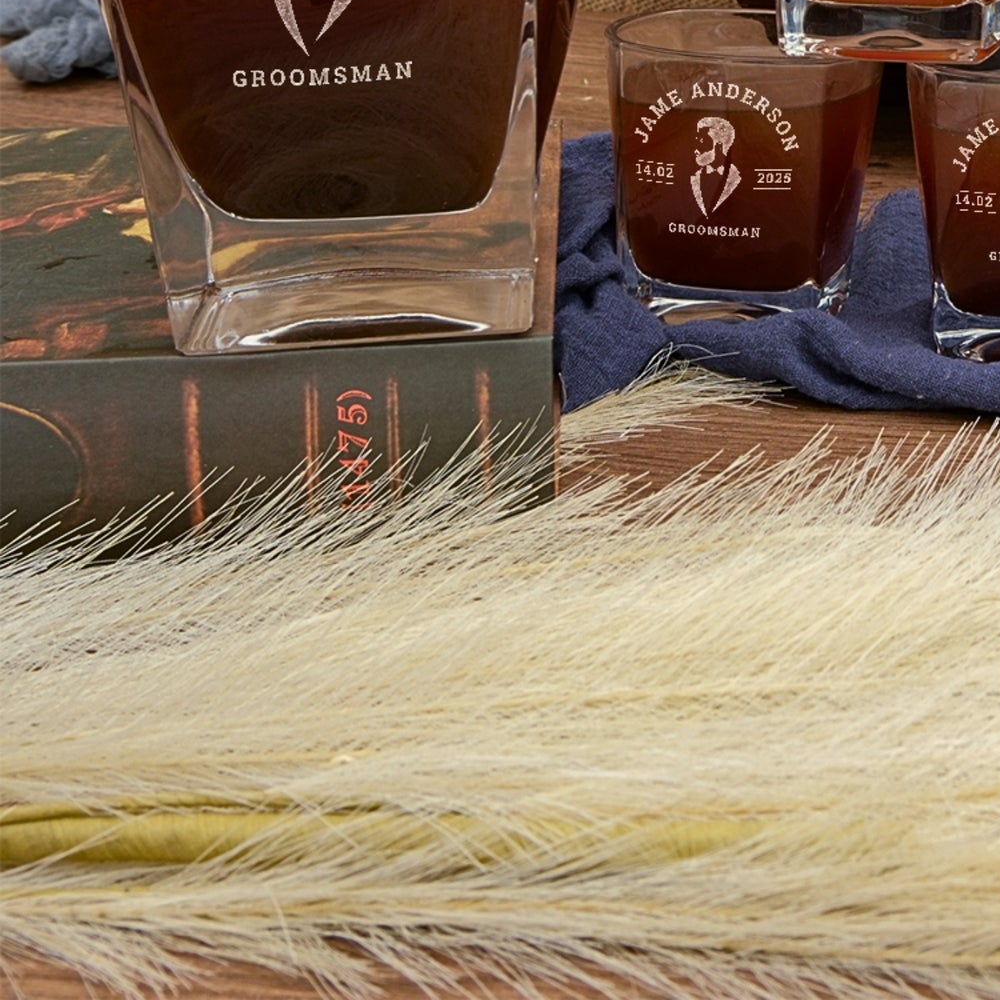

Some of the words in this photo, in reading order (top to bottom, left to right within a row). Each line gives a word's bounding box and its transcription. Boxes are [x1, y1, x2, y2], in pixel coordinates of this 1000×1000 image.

[232, 61, 414, 88] GROOMSMAN
[634, 89, 683, 143] JAME
[691, 82, 799, 151] ANDERSON
[952, 118, 1000, 173] JAME
[635, 163, 675, 178] 14.02
[757, 172, 792, 184] 2025
[955, 194, 993, 208] 14.02
[668, 222, 761, 238] GROOMSMAN
